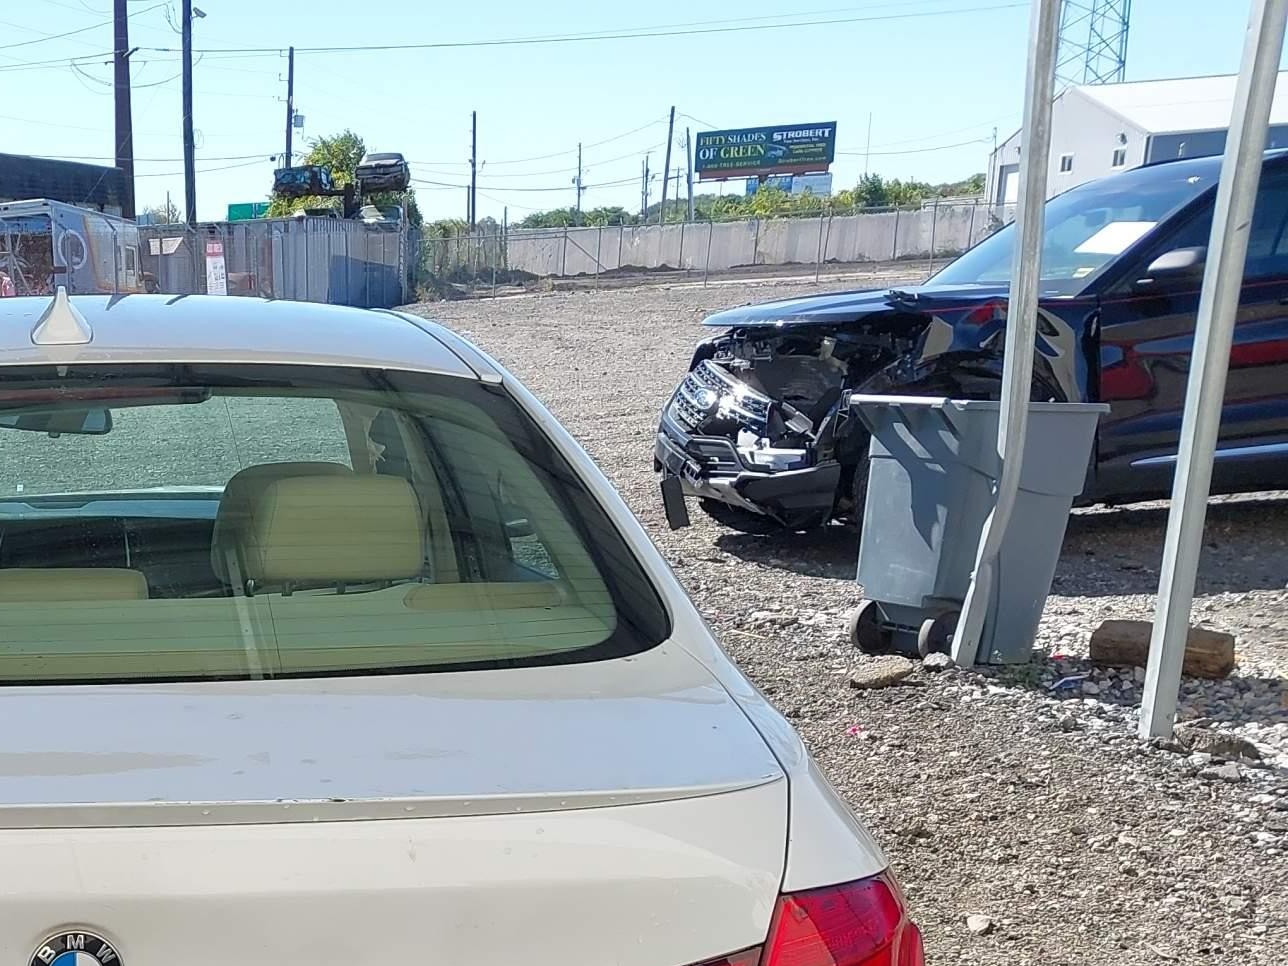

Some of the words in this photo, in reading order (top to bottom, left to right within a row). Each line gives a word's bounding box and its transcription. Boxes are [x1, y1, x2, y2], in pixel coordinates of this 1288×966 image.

[700, 135, 726, 146] FIFTY
[727, 132, 767, 144] SHADES
[772, 127, 832, 142] STROBERT
[699, 147, 718, 160] OF
[720, 144, 765, 159] GREEN
[37, 934, 116, 966] BMW
